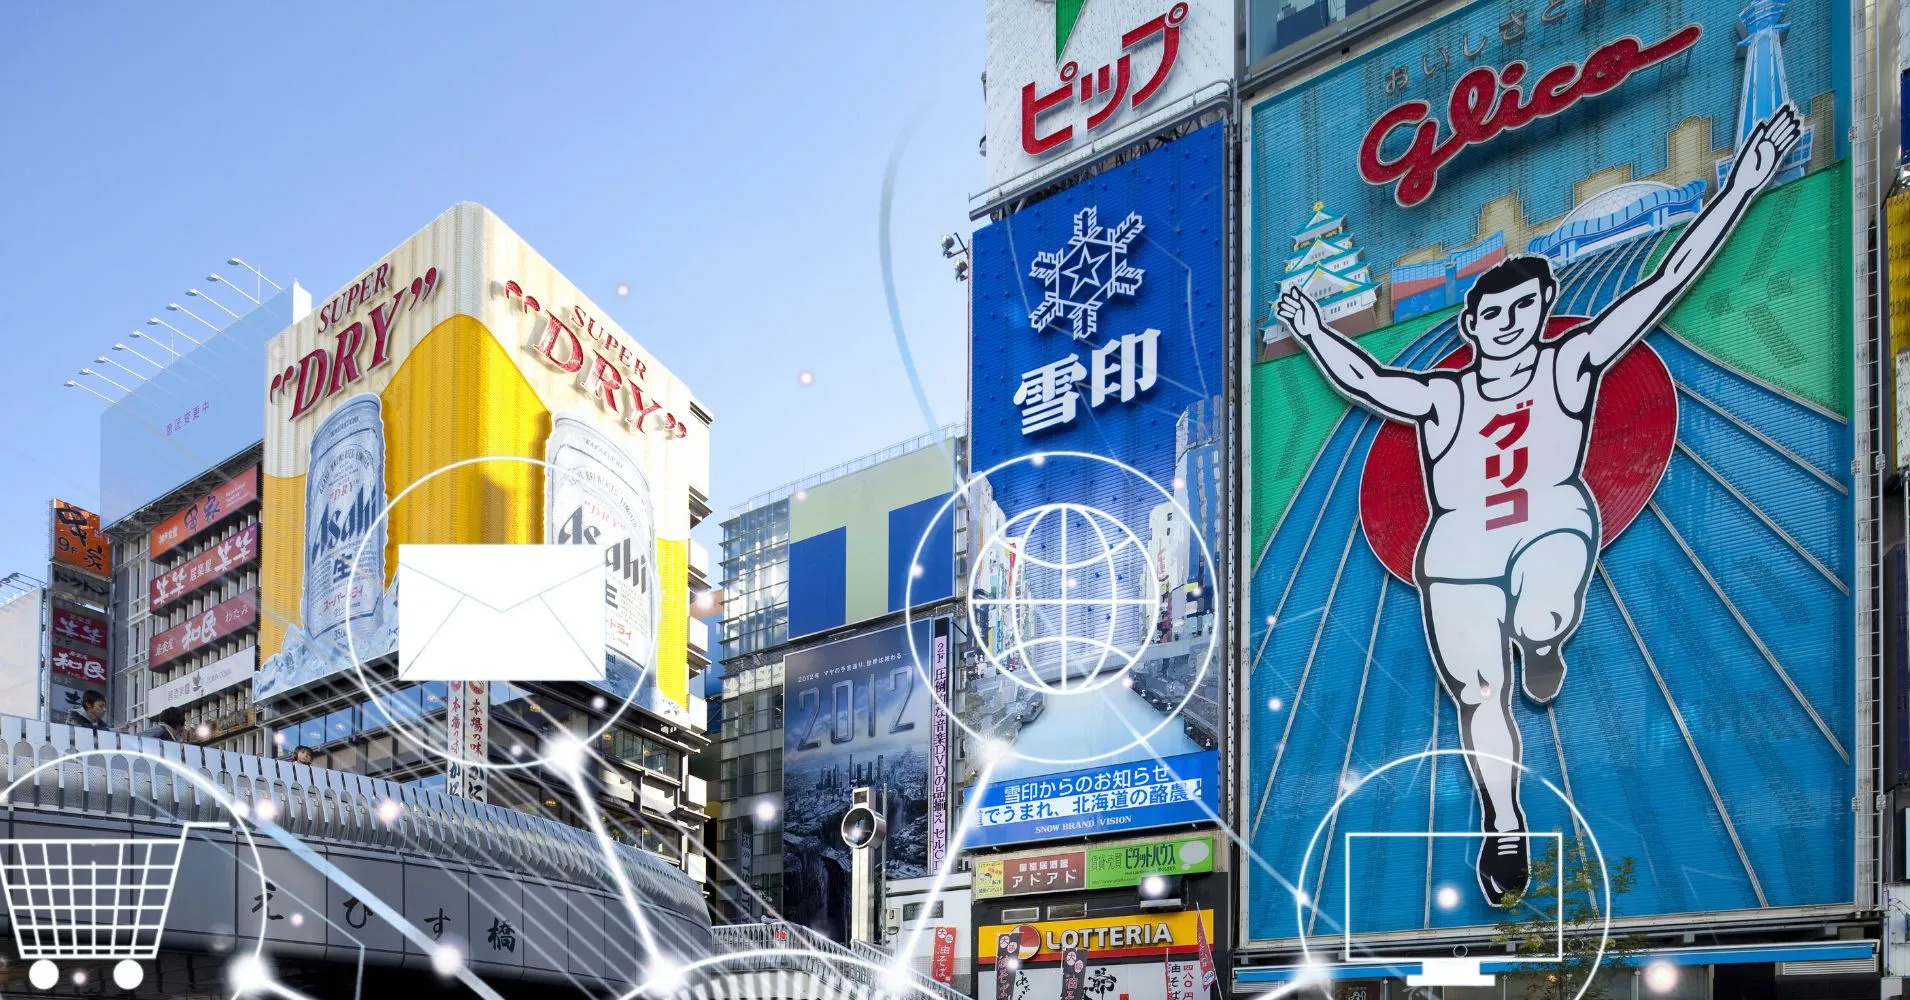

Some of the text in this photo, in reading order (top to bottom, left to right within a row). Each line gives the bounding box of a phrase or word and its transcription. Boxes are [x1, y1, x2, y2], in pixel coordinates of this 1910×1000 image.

[1385, 0, 1569, 95] おいしさと
[1021, 1, 1190, 155] ピップ
[317, 262, 392, 334] SUPER
[572, 304, 648, 382] SUPER
[1012, 328, 1161, 435] 雪印
[1478, 400, 1535, 532] グリコ
[312, 485, 377, 565] Asahi
[328, 553, 353, 584] 生
[324, 586, 364, 612] スーパーライ
[52, 652, 107, 681] 和民
[798, 673, 821, 684] 2012年
[469, 698, 484, 756] 本場の味
[797, 665, 915, 752] 2012
[1004, 764, 1171, 804] 雪印からのお知らせ
[1035, 815, 1133, 834] SNOW BRAND VISION
[1012, 868, 1077, 889] アドアド
[1125, 843, 1177, 870] ピタットハウス
[1046, 923, 1173, 951] LOTTERIA
